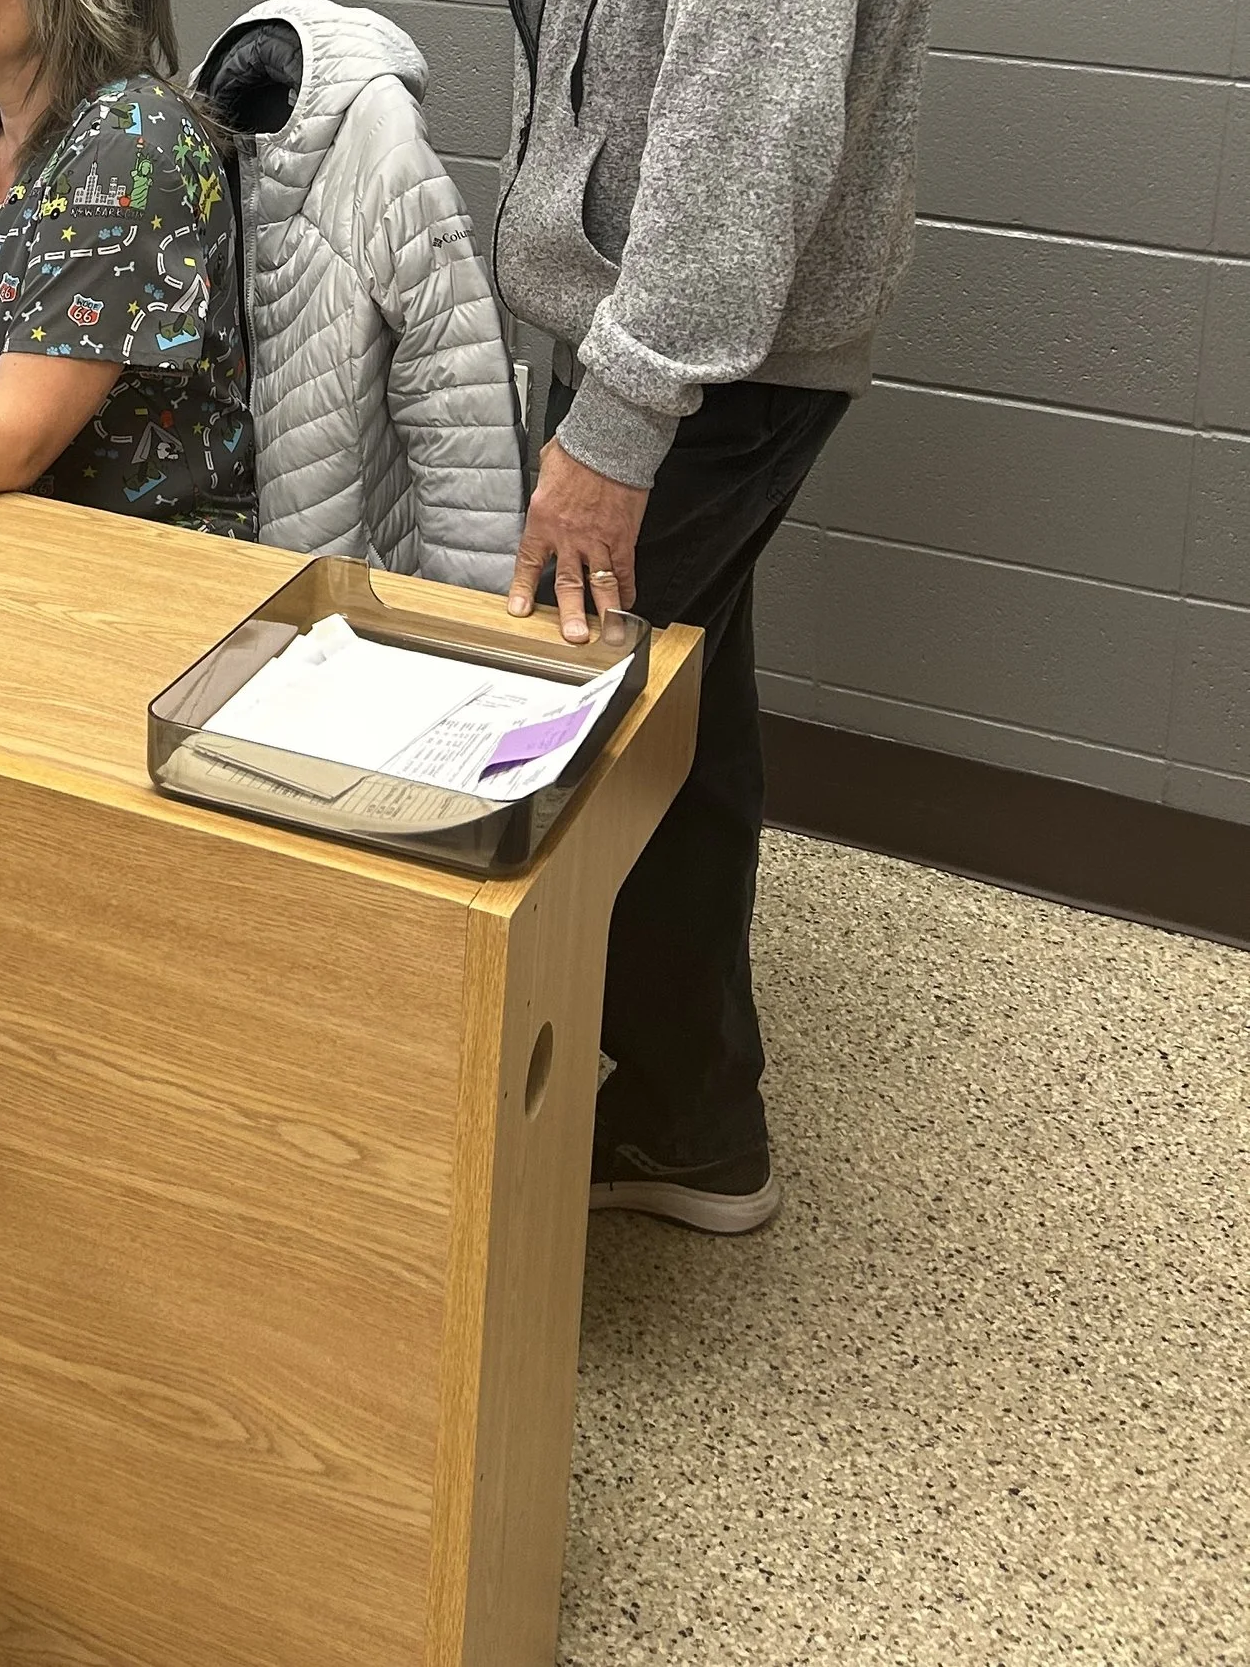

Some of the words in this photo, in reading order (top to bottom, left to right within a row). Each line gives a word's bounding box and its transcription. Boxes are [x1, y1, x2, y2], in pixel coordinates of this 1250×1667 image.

[71, 207, 92, 218] NEW
[96, 206, 123, 216] BARK
[73, 307, 92, 323] 66
